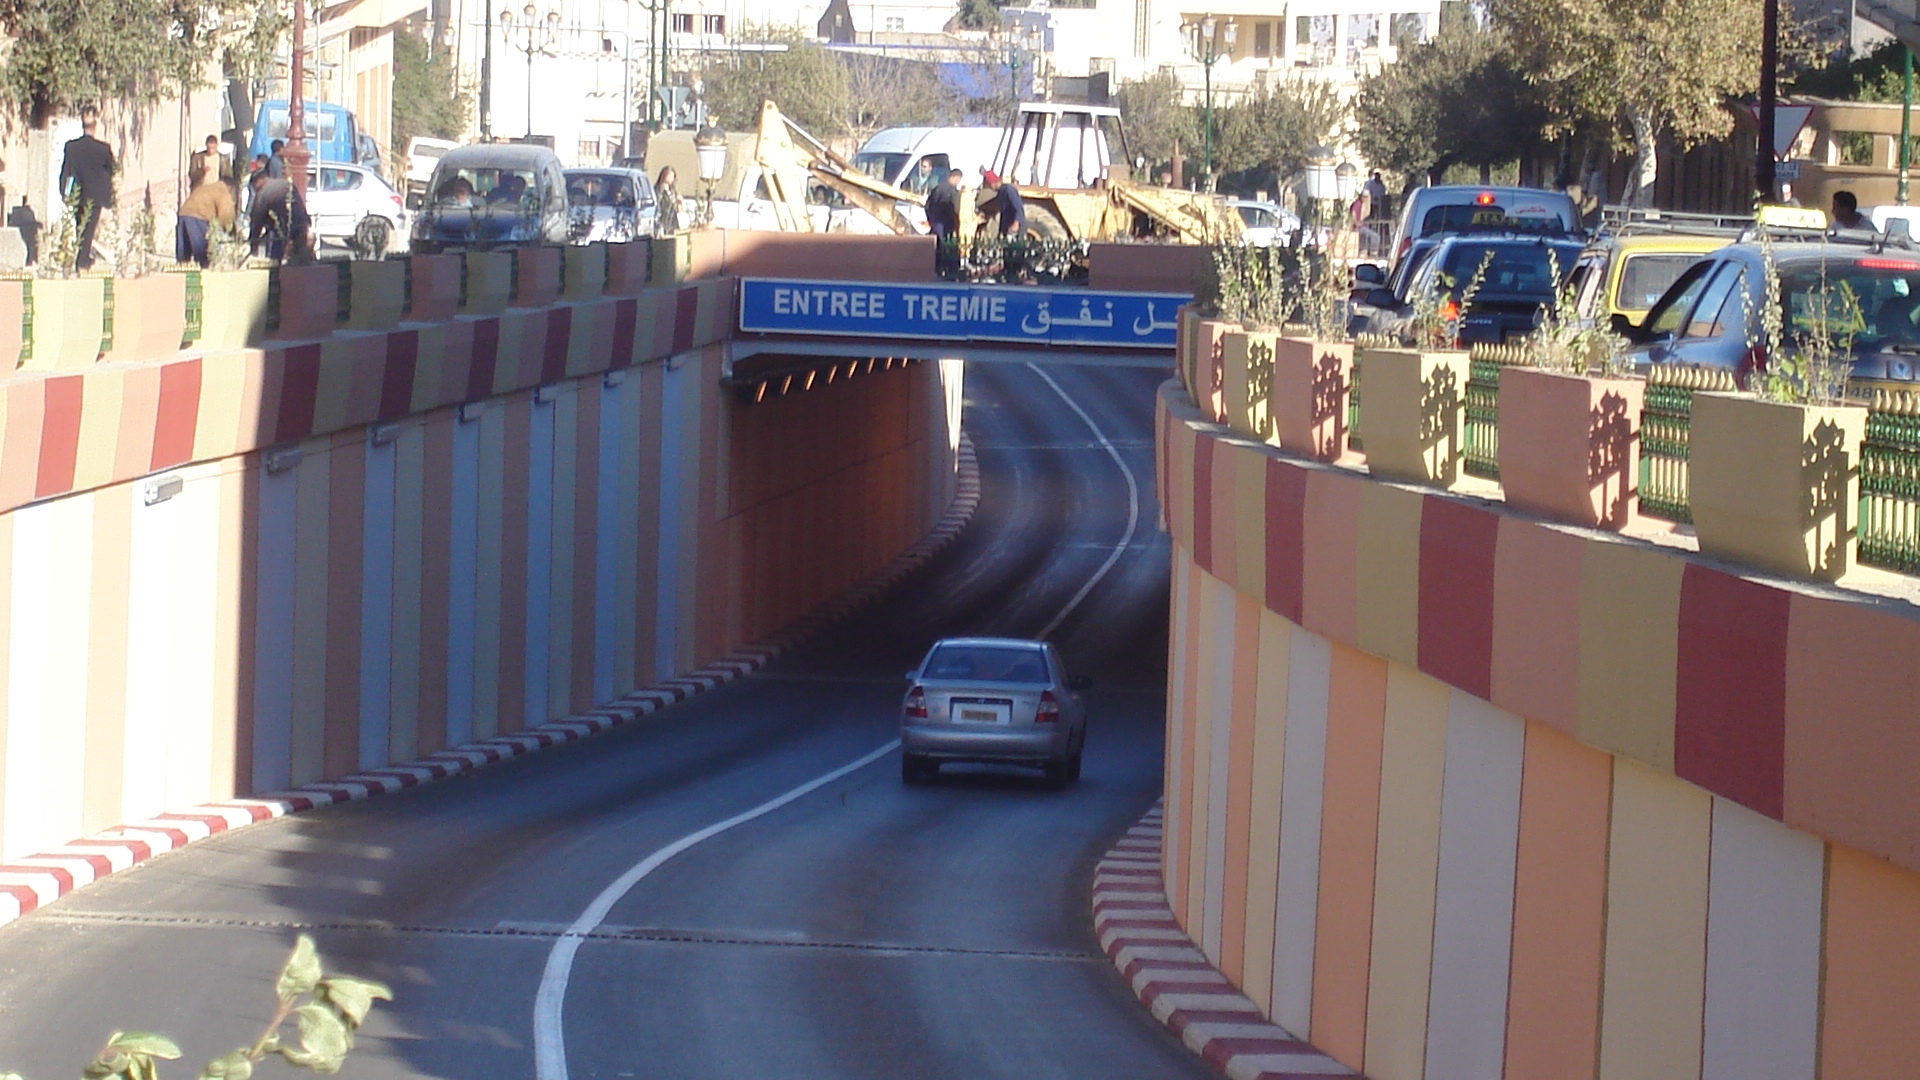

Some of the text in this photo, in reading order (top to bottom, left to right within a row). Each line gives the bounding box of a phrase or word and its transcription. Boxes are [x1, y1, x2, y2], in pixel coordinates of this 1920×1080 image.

[773, 288, 1007, 323] ENTREE TREMIE
[1021, 298, 1114, 335] نفق
